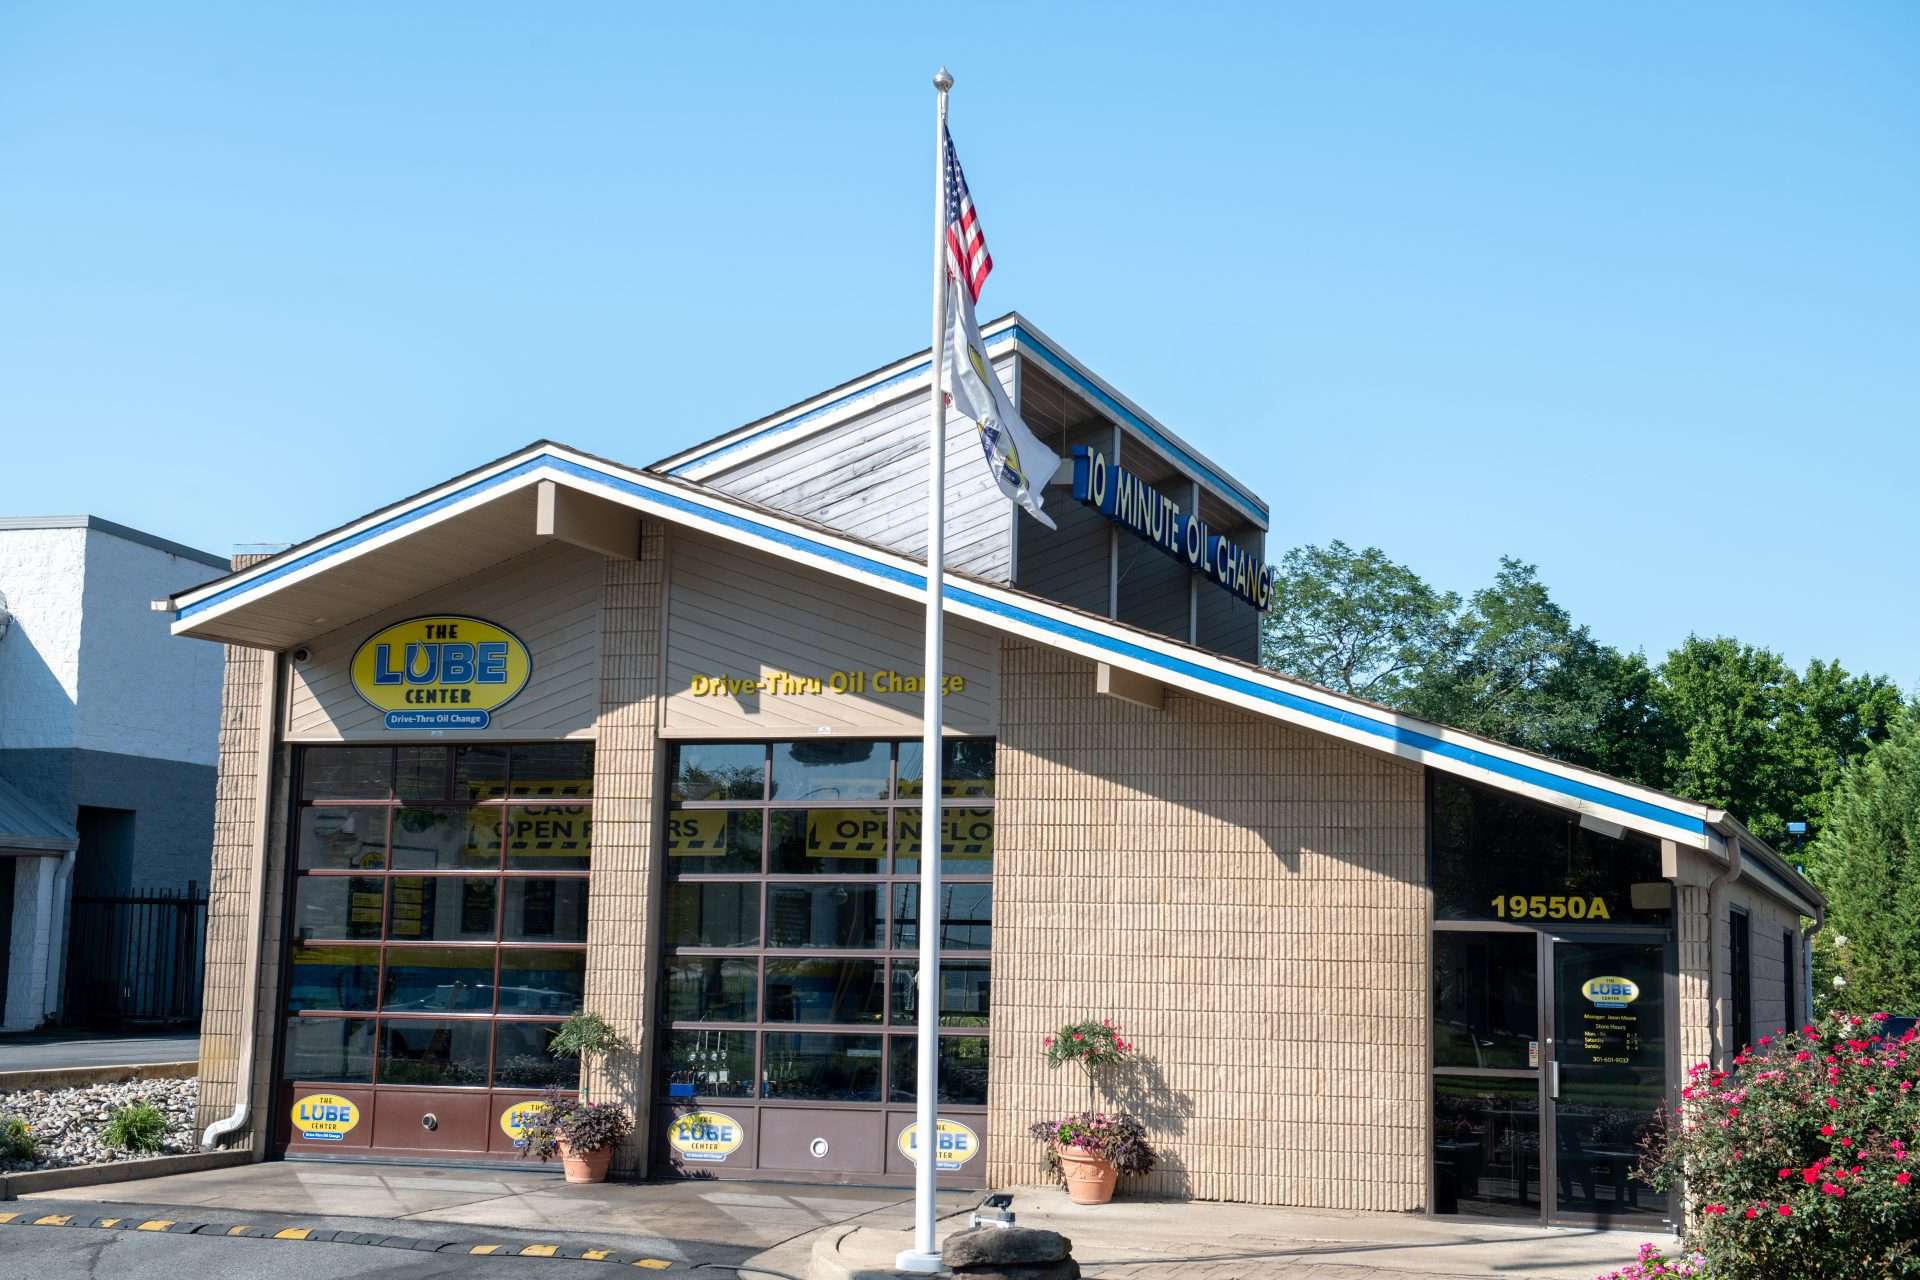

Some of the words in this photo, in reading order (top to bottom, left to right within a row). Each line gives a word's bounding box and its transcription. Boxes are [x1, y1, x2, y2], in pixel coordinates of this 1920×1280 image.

[1087, 446, 1106, 507] 10
[1115, 467, 1180, 553] MINUTE
[1186, 515, 1211, 572] OIL
[425, 624, 458, 640] THE
[374, 640, 509, 686] LUBE
[691, 672, 822, 697] Drive-Thru
[828, 671, 865, 694] Oil
[405, 689, 471, 704] CENTER
[391, 715, 435, 724] Drive-Thru
[437, 714, 449, 723] Oil
[450, 714, 481, 724] Change
[494, 820, 573, 838] OPEN
[1491, 895, 1610, 920] 19550A
[1590, 984, 1632, 995] LUBE
[300, 1104, 351, 1122] LUBE
[910, 1132, 967, 1150] LBE
